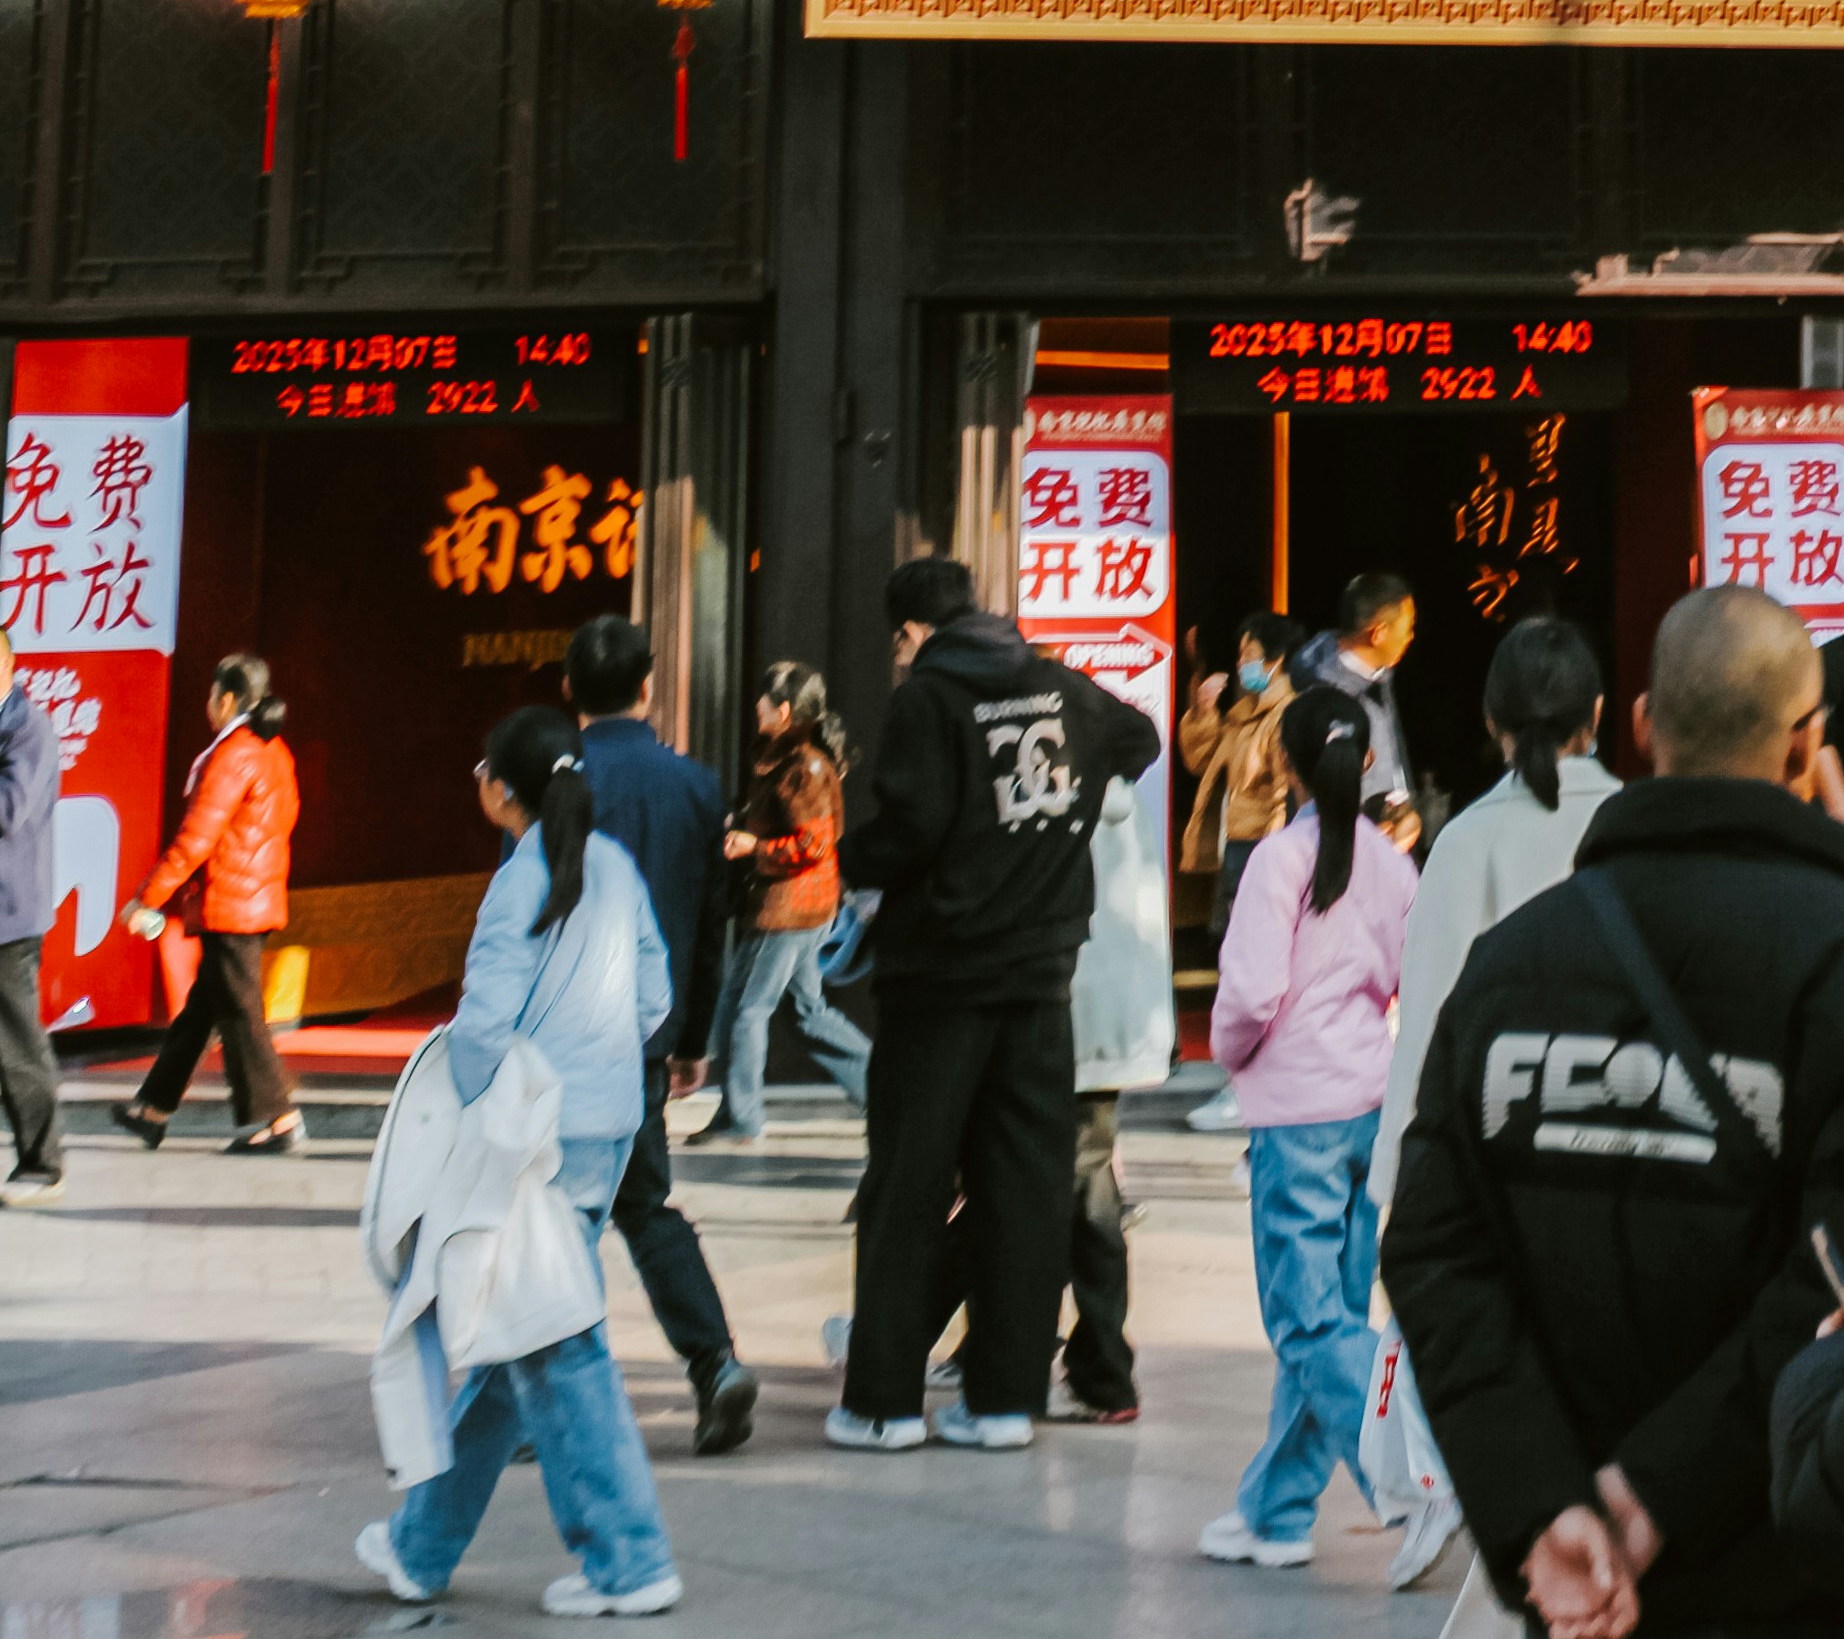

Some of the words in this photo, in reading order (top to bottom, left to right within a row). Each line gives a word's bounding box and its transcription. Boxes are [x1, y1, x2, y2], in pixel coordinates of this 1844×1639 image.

[514, 333, 592, 366] 14:40
[1512, 320, 1593, 353] 14:40
[511, 378, 540, 413] 人
[1511, 364, 1543, 401] 人
[2, 431, 153, 535] 免费
[1021, 467, 1154, 529] 免费
[1719, 460, 1842, 519] 免费
[0, 541, 155, 635] 开放
[1019, 537, 1156, 603] 开放
